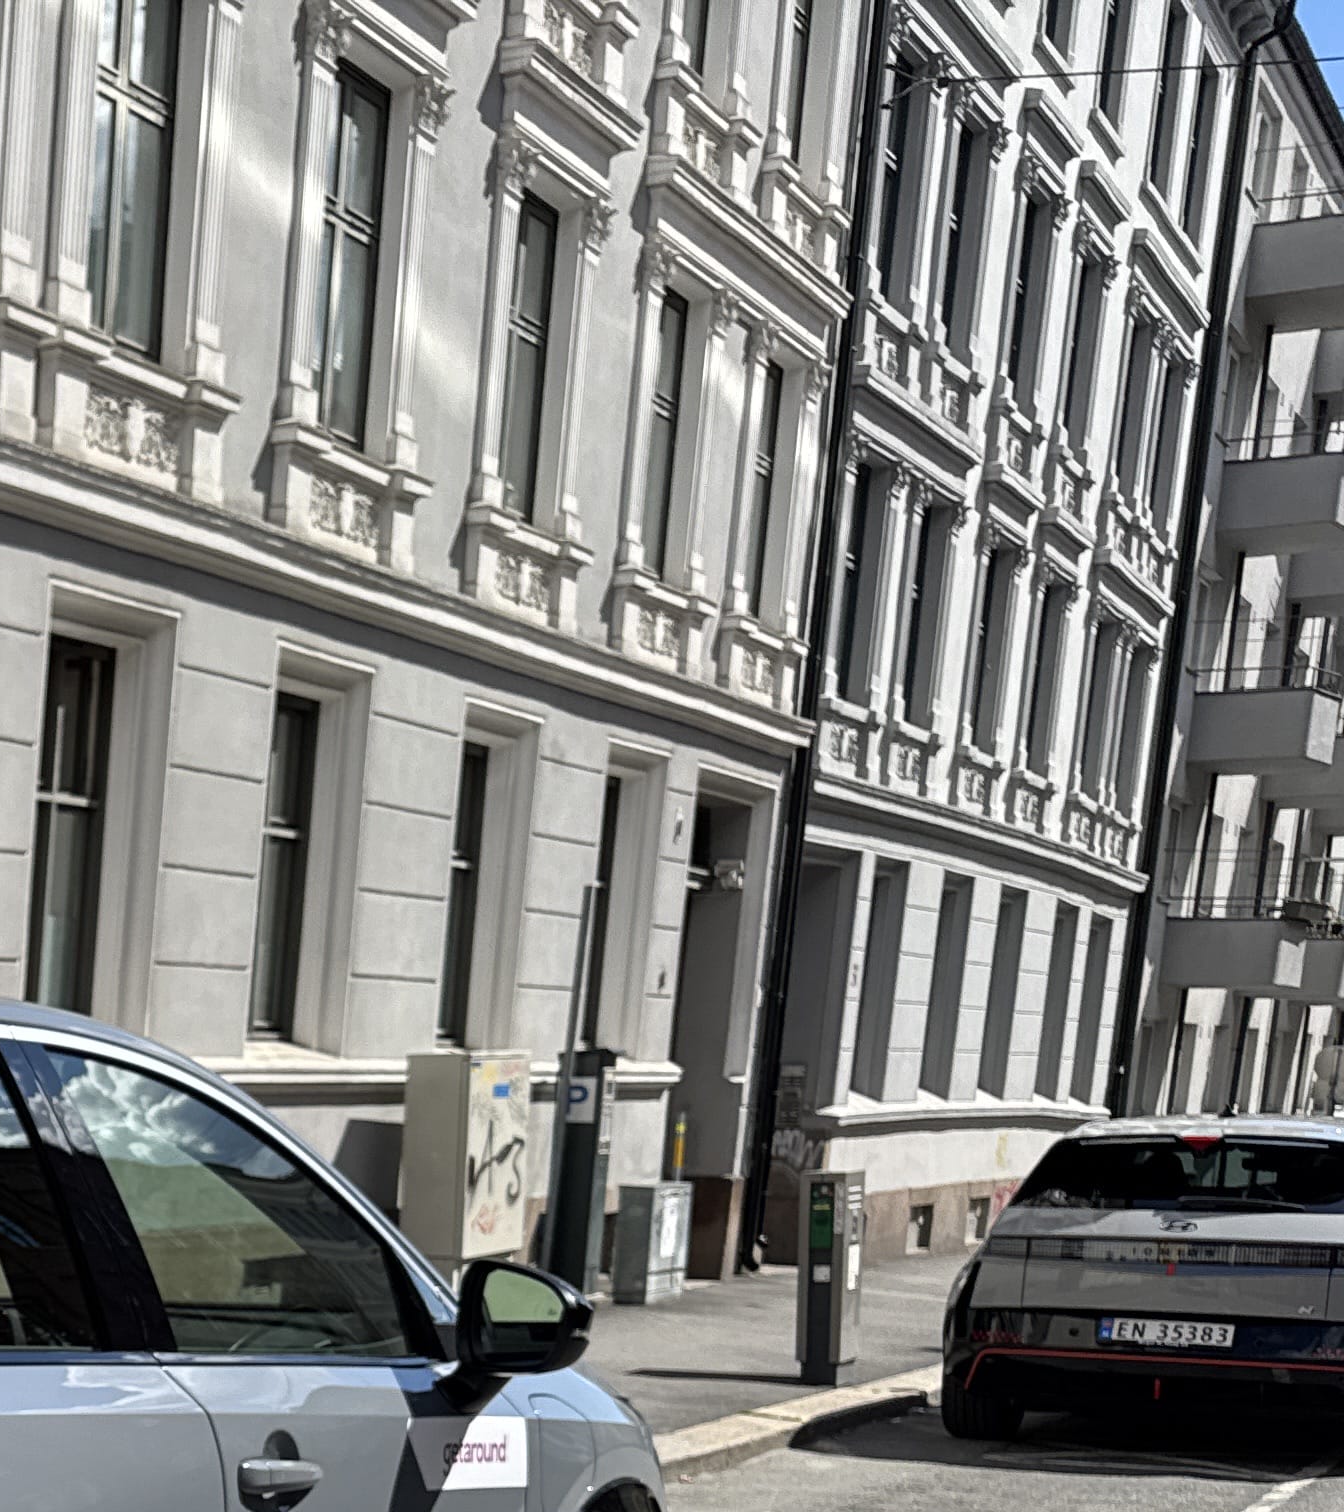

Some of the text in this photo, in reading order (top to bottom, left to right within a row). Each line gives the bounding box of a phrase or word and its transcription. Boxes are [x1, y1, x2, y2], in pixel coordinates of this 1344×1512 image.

[568, 1085, 588, 1116] P
[1116, 1321, 1146, 1339] EN
[1156, 1323, 1229, 1344] 35383
[443, 1433, 507, 1477] getaround
